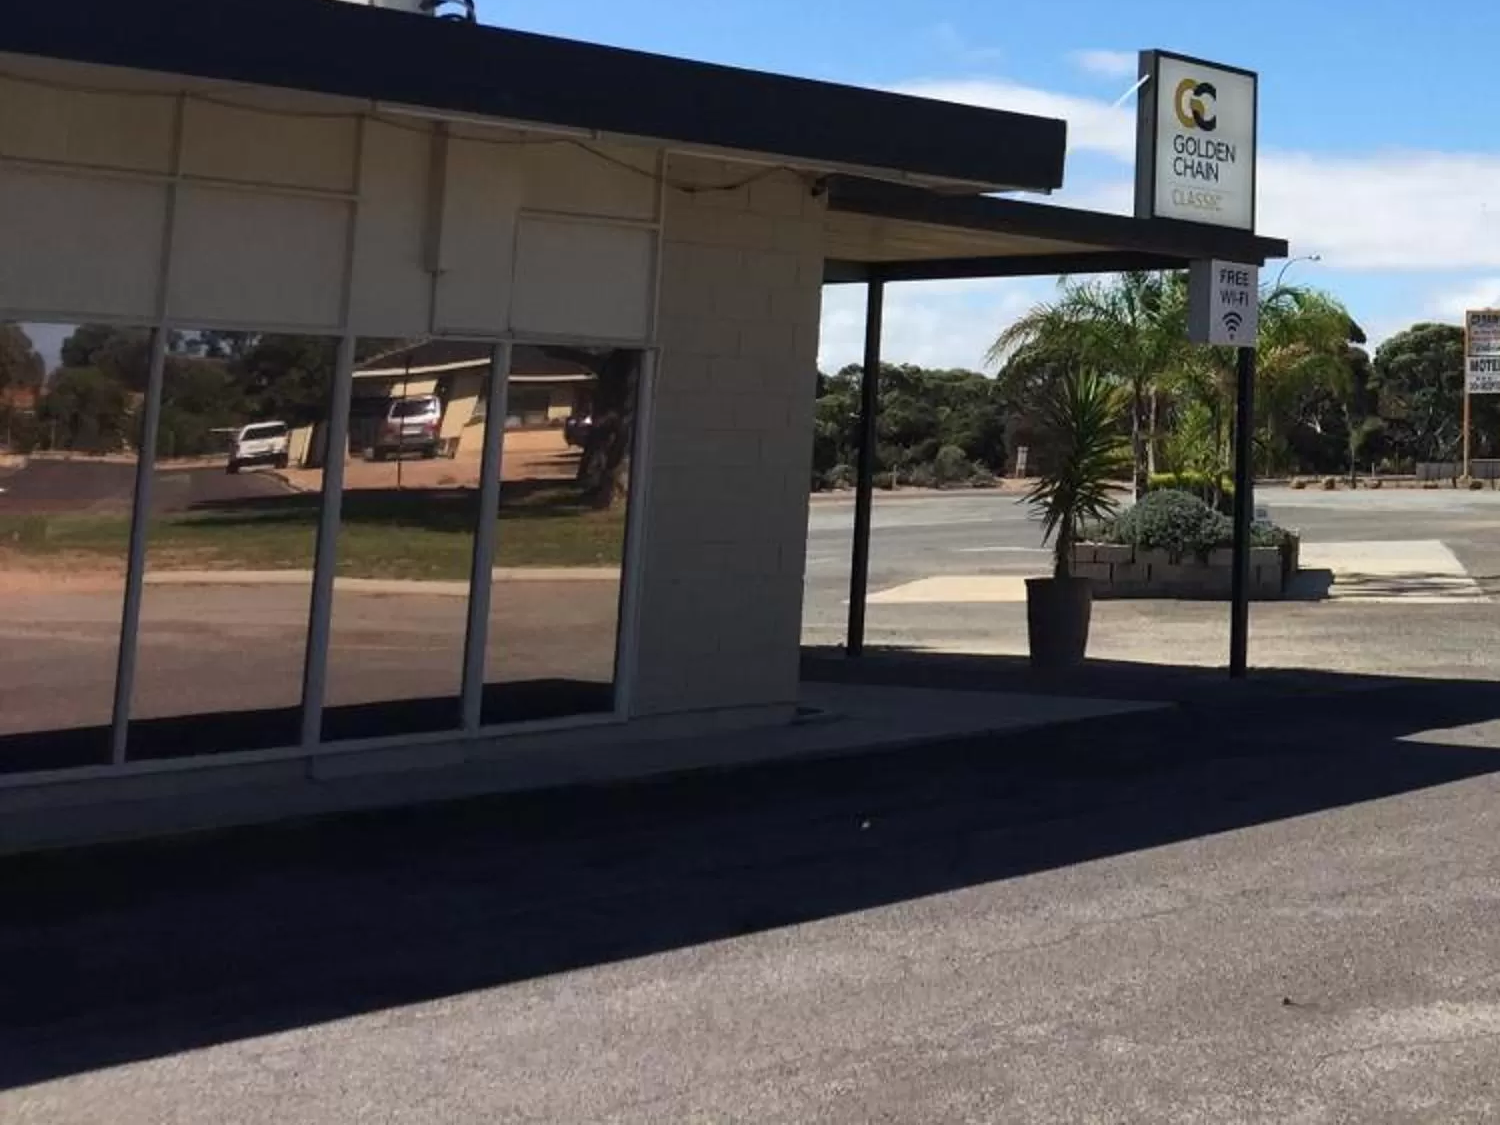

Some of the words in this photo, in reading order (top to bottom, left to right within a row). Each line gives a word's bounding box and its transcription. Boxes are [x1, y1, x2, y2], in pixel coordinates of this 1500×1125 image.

[1173, 134, 1236, 164] GOLDEN
[1173, 156, 1219, 183] CHAIN
[1219, 268, 1249, 287] FREE
[1220, 290, 1249, 308] WI-FI
